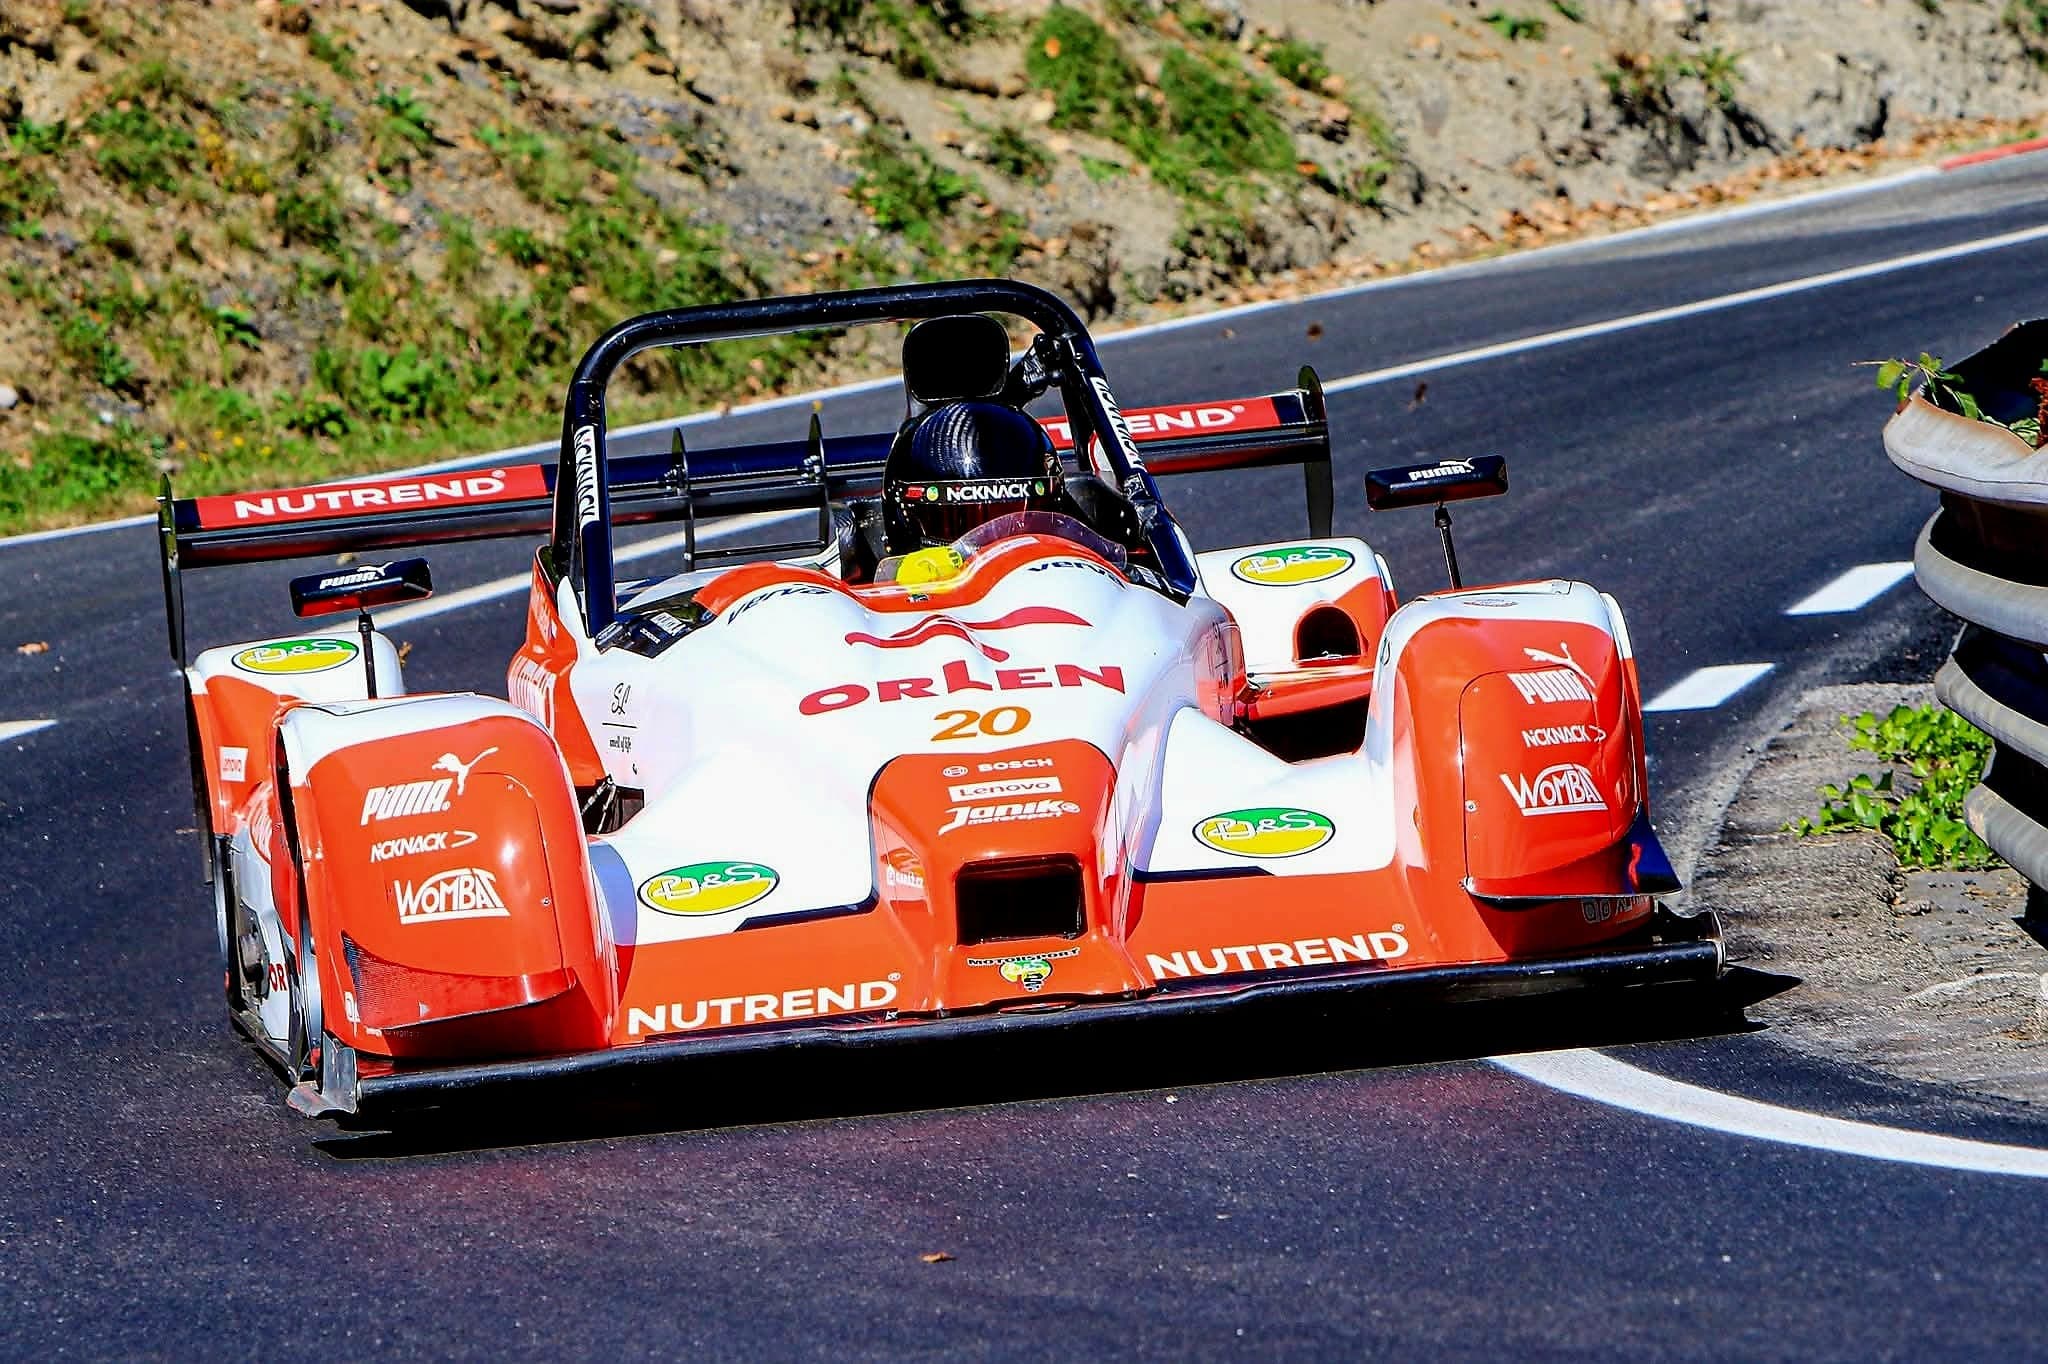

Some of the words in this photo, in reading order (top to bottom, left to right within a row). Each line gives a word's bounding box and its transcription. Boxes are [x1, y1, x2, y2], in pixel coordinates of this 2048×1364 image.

[799, 660, 1126, 716] ORLEN
[930, 706, 1032, 742] 20
[977, 757, 1054, 773] BOSCH
[959, 782, 1051, 797] Lenovo
[938, 799, 1065, 836] Janik
